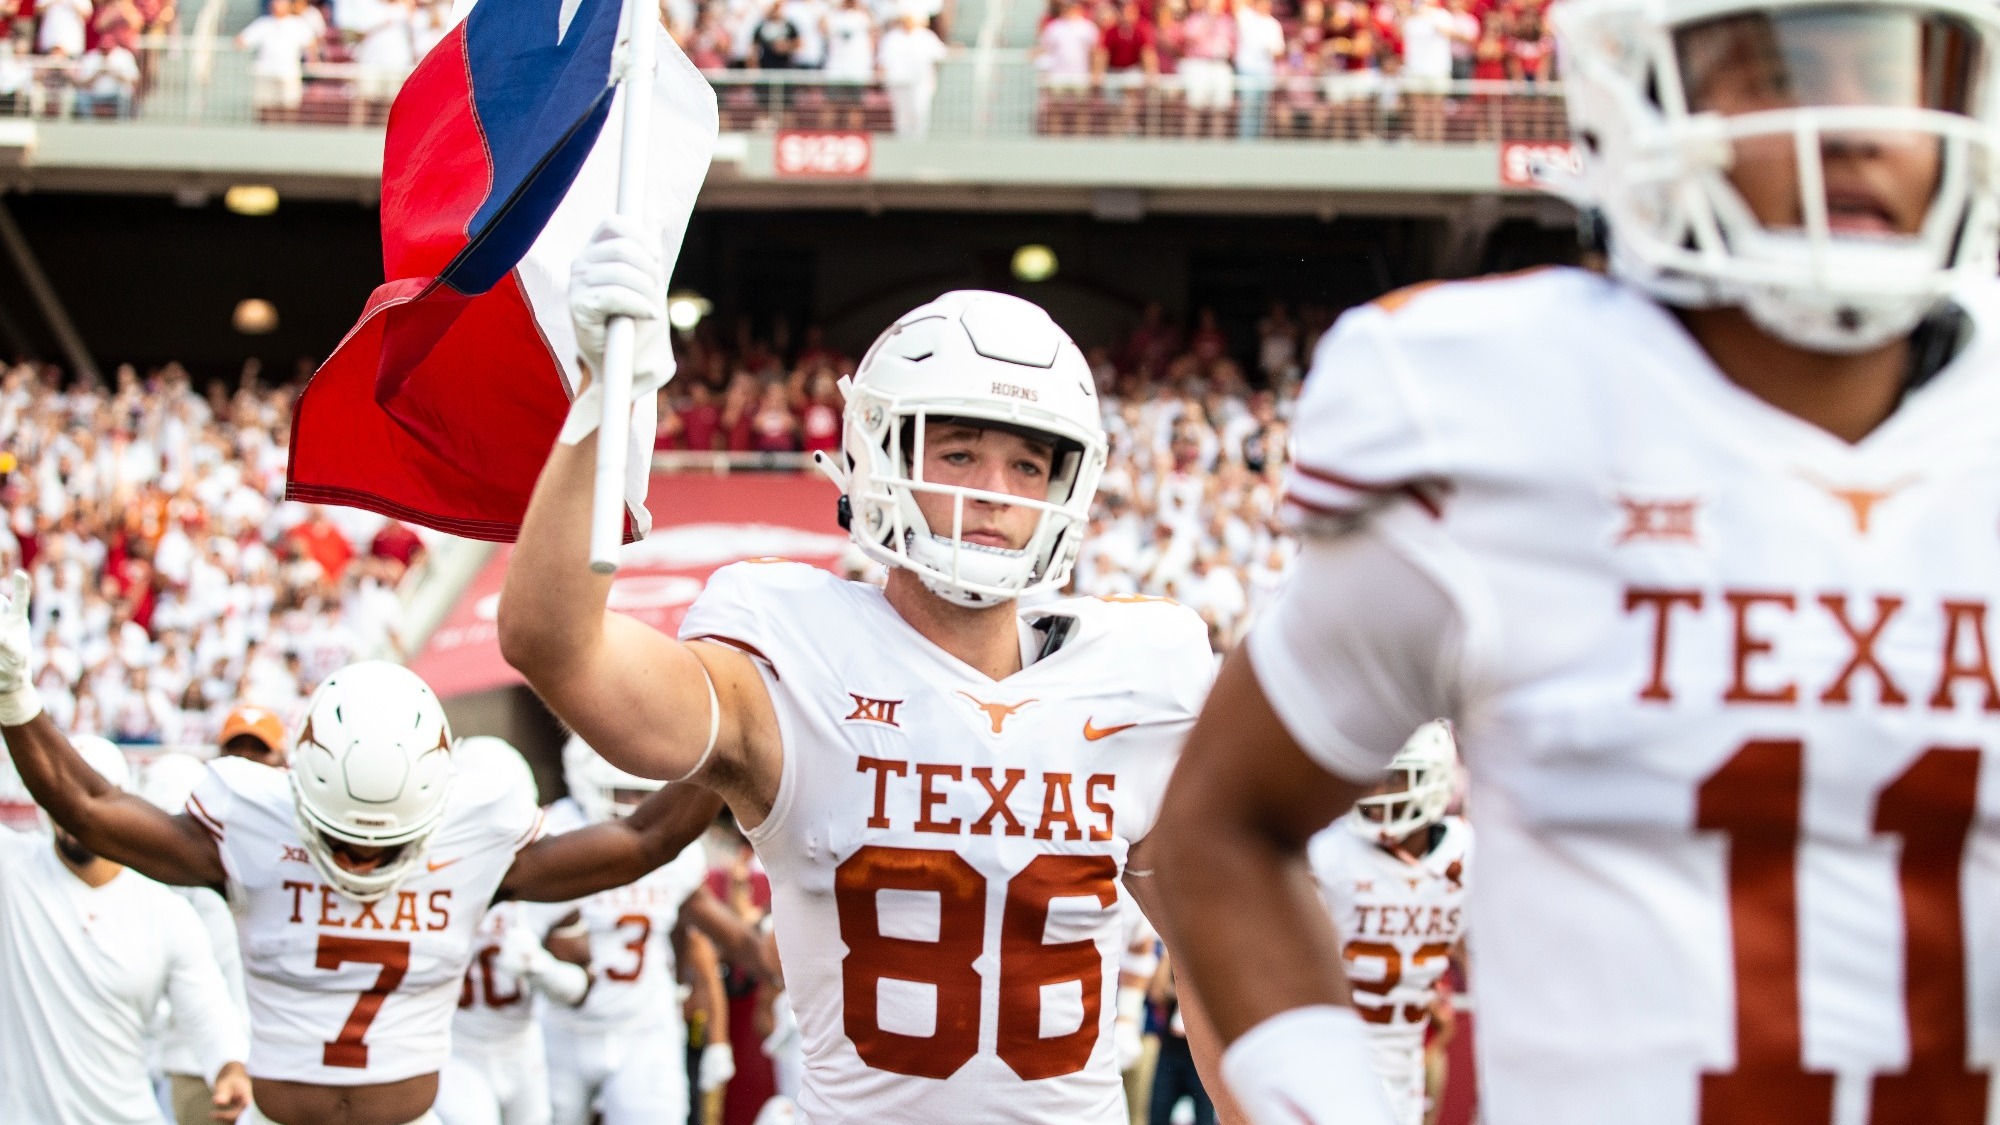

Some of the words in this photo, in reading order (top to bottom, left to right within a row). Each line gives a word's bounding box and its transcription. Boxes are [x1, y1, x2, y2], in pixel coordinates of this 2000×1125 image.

[991, 382, 1038, 402] HORNS
[1624, 587, 2000, 712] TEXA
[845, 692, 903, 727] XII
[857, 756, 1115, 841] TEXAS
[283, 880, 452, 931] TEXAS
[1355, 905, 1460, 936] TEXAS
[1694, 740, 1991, 1125] 11
[605, 914, 651, 982] 3
[835, 845, 1118, 1081] 86
[315, 935, 410, 1068] 7
